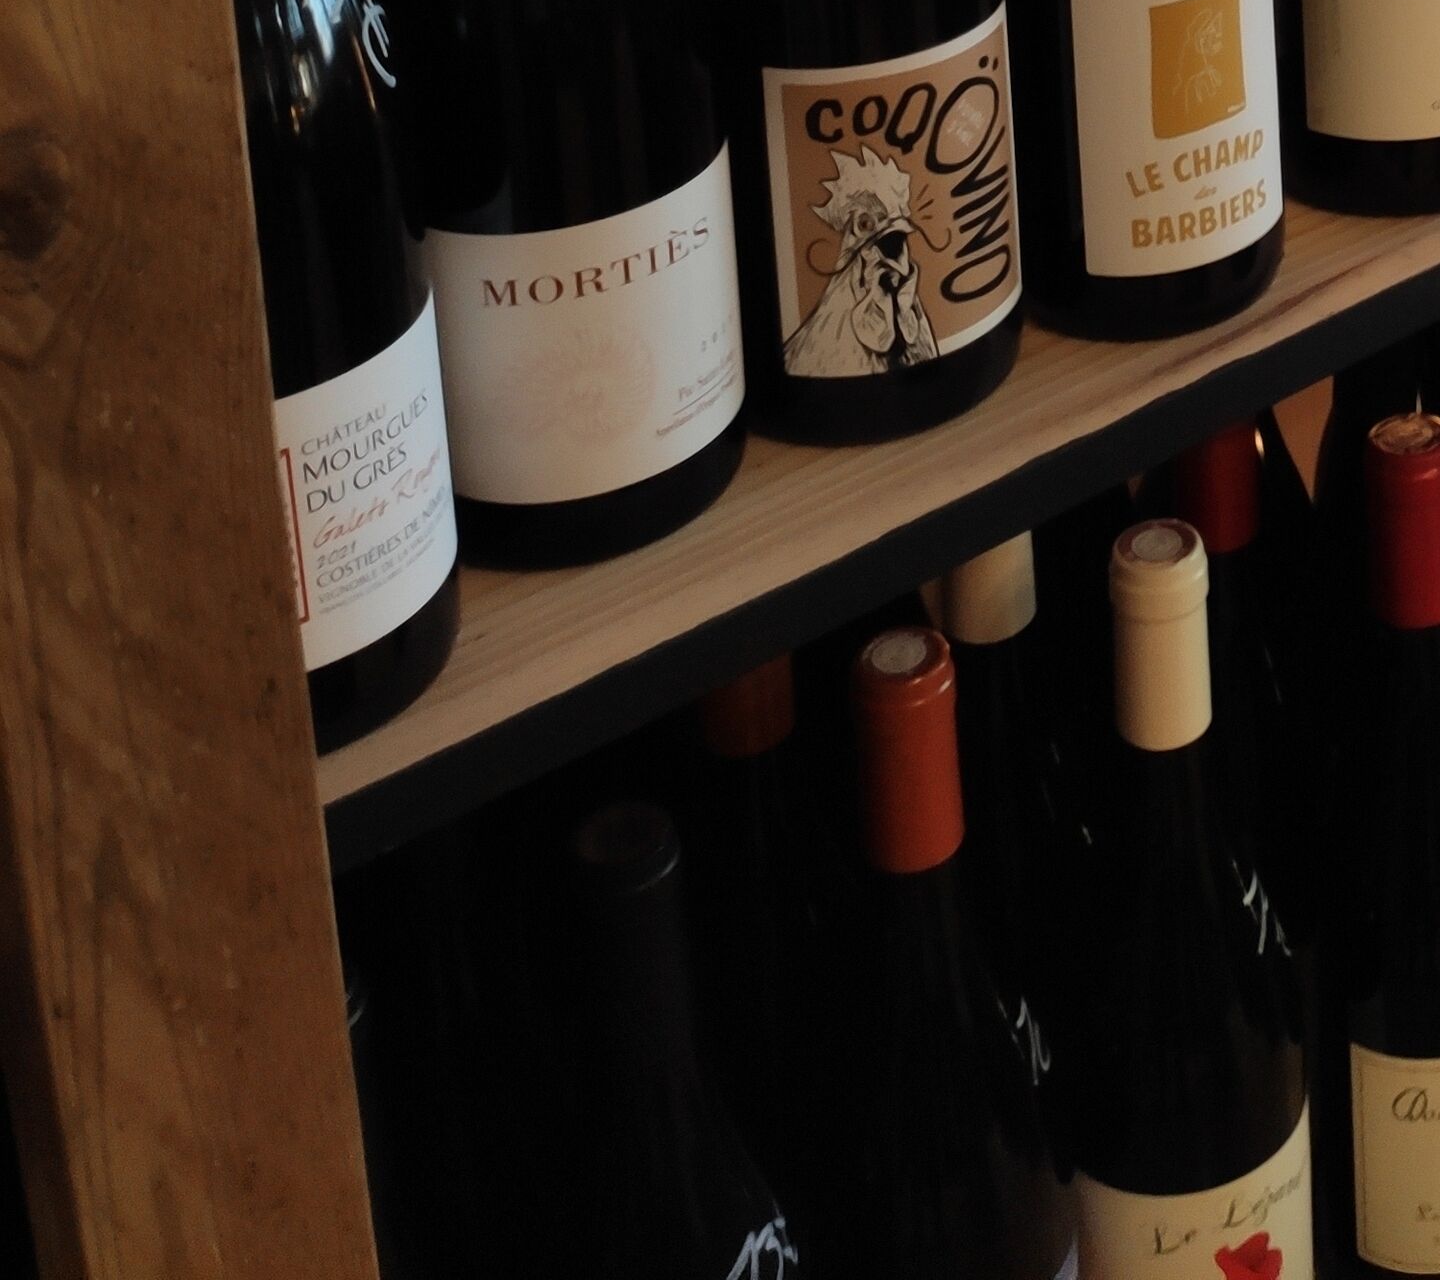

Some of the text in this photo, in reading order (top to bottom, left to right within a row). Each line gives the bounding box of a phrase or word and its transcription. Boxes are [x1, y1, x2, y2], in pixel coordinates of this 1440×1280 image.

[1126, 128, 1264, 198] LE CHAMP
[1131, 179, 1267, 250] BARBIERS
[480, 217, 711, 308] MORTIÈS
[301, 402, 387, 456] CHÂTEAU
[302, 389, 430, 484] MOURGUES
[306, 441, 408, 514] DU GRÈS
